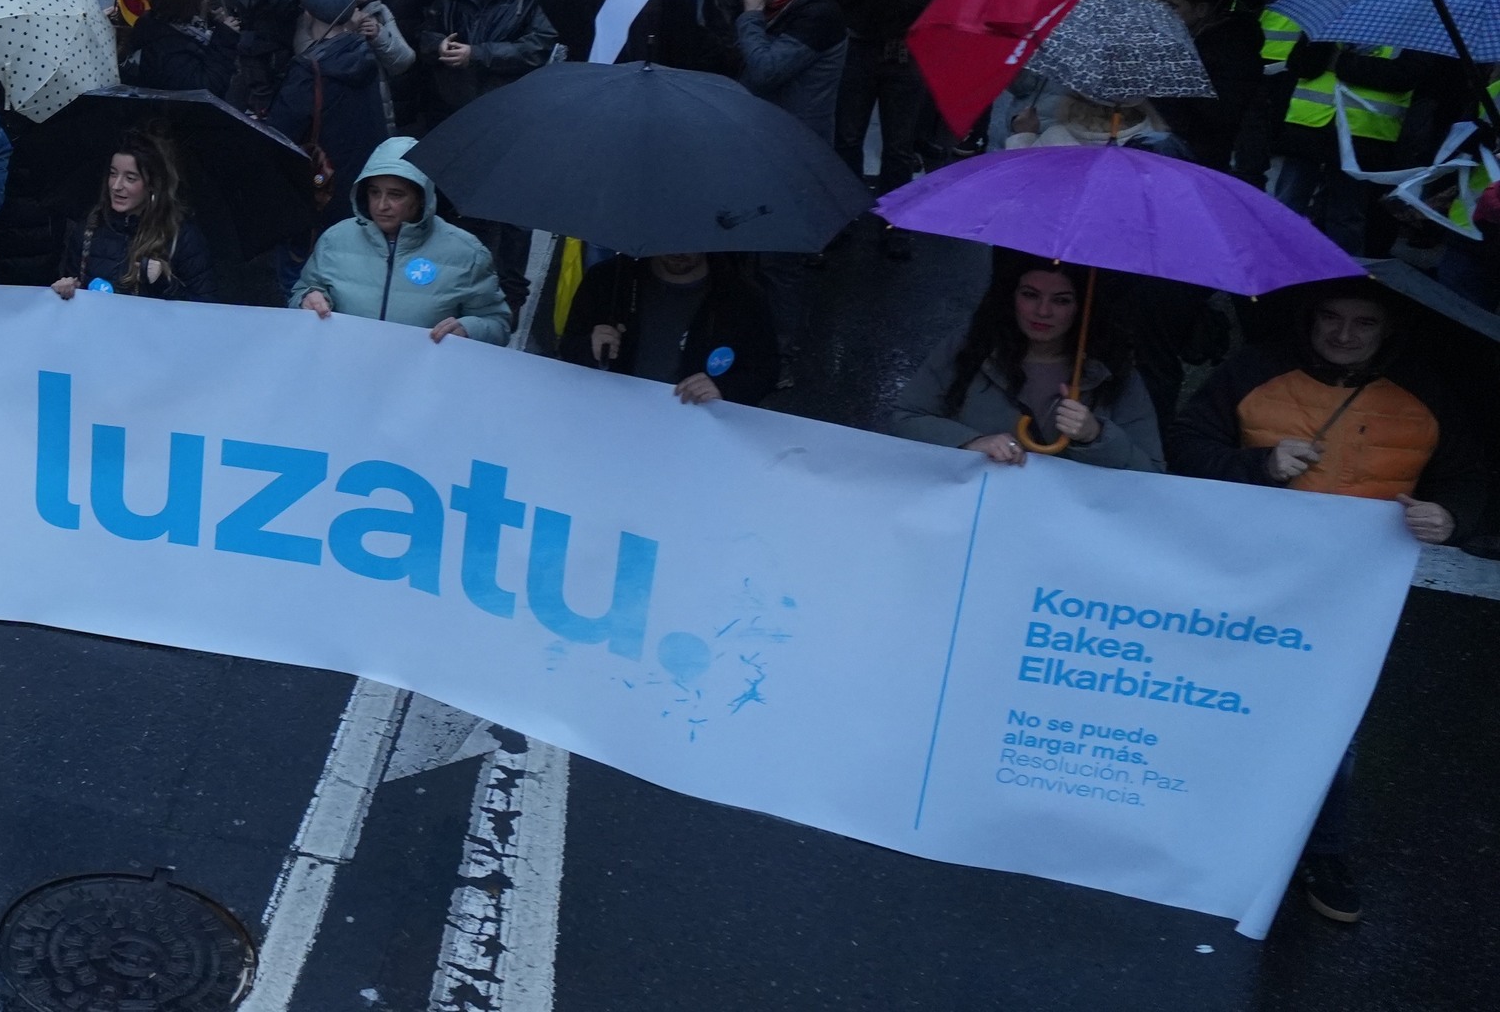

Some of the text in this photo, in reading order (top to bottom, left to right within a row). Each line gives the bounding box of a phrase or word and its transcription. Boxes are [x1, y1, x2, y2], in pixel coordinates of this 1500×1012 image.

[35, 370, 713, 680] luzatu.
[1032, 587, 1313, 652] Konponbidea.
[1025, 622, 1154, 664] Bakea.
[1018, 656, 1251, 716] Elkarbizitza.
[1002, 729, 1149, 766] alargar más.
[1007, 709, 1159, 747] No se puede
[996, 767, 1145, 807] Convivencia.
[1000, 748, 1188, 792] Resolución. Paz.
